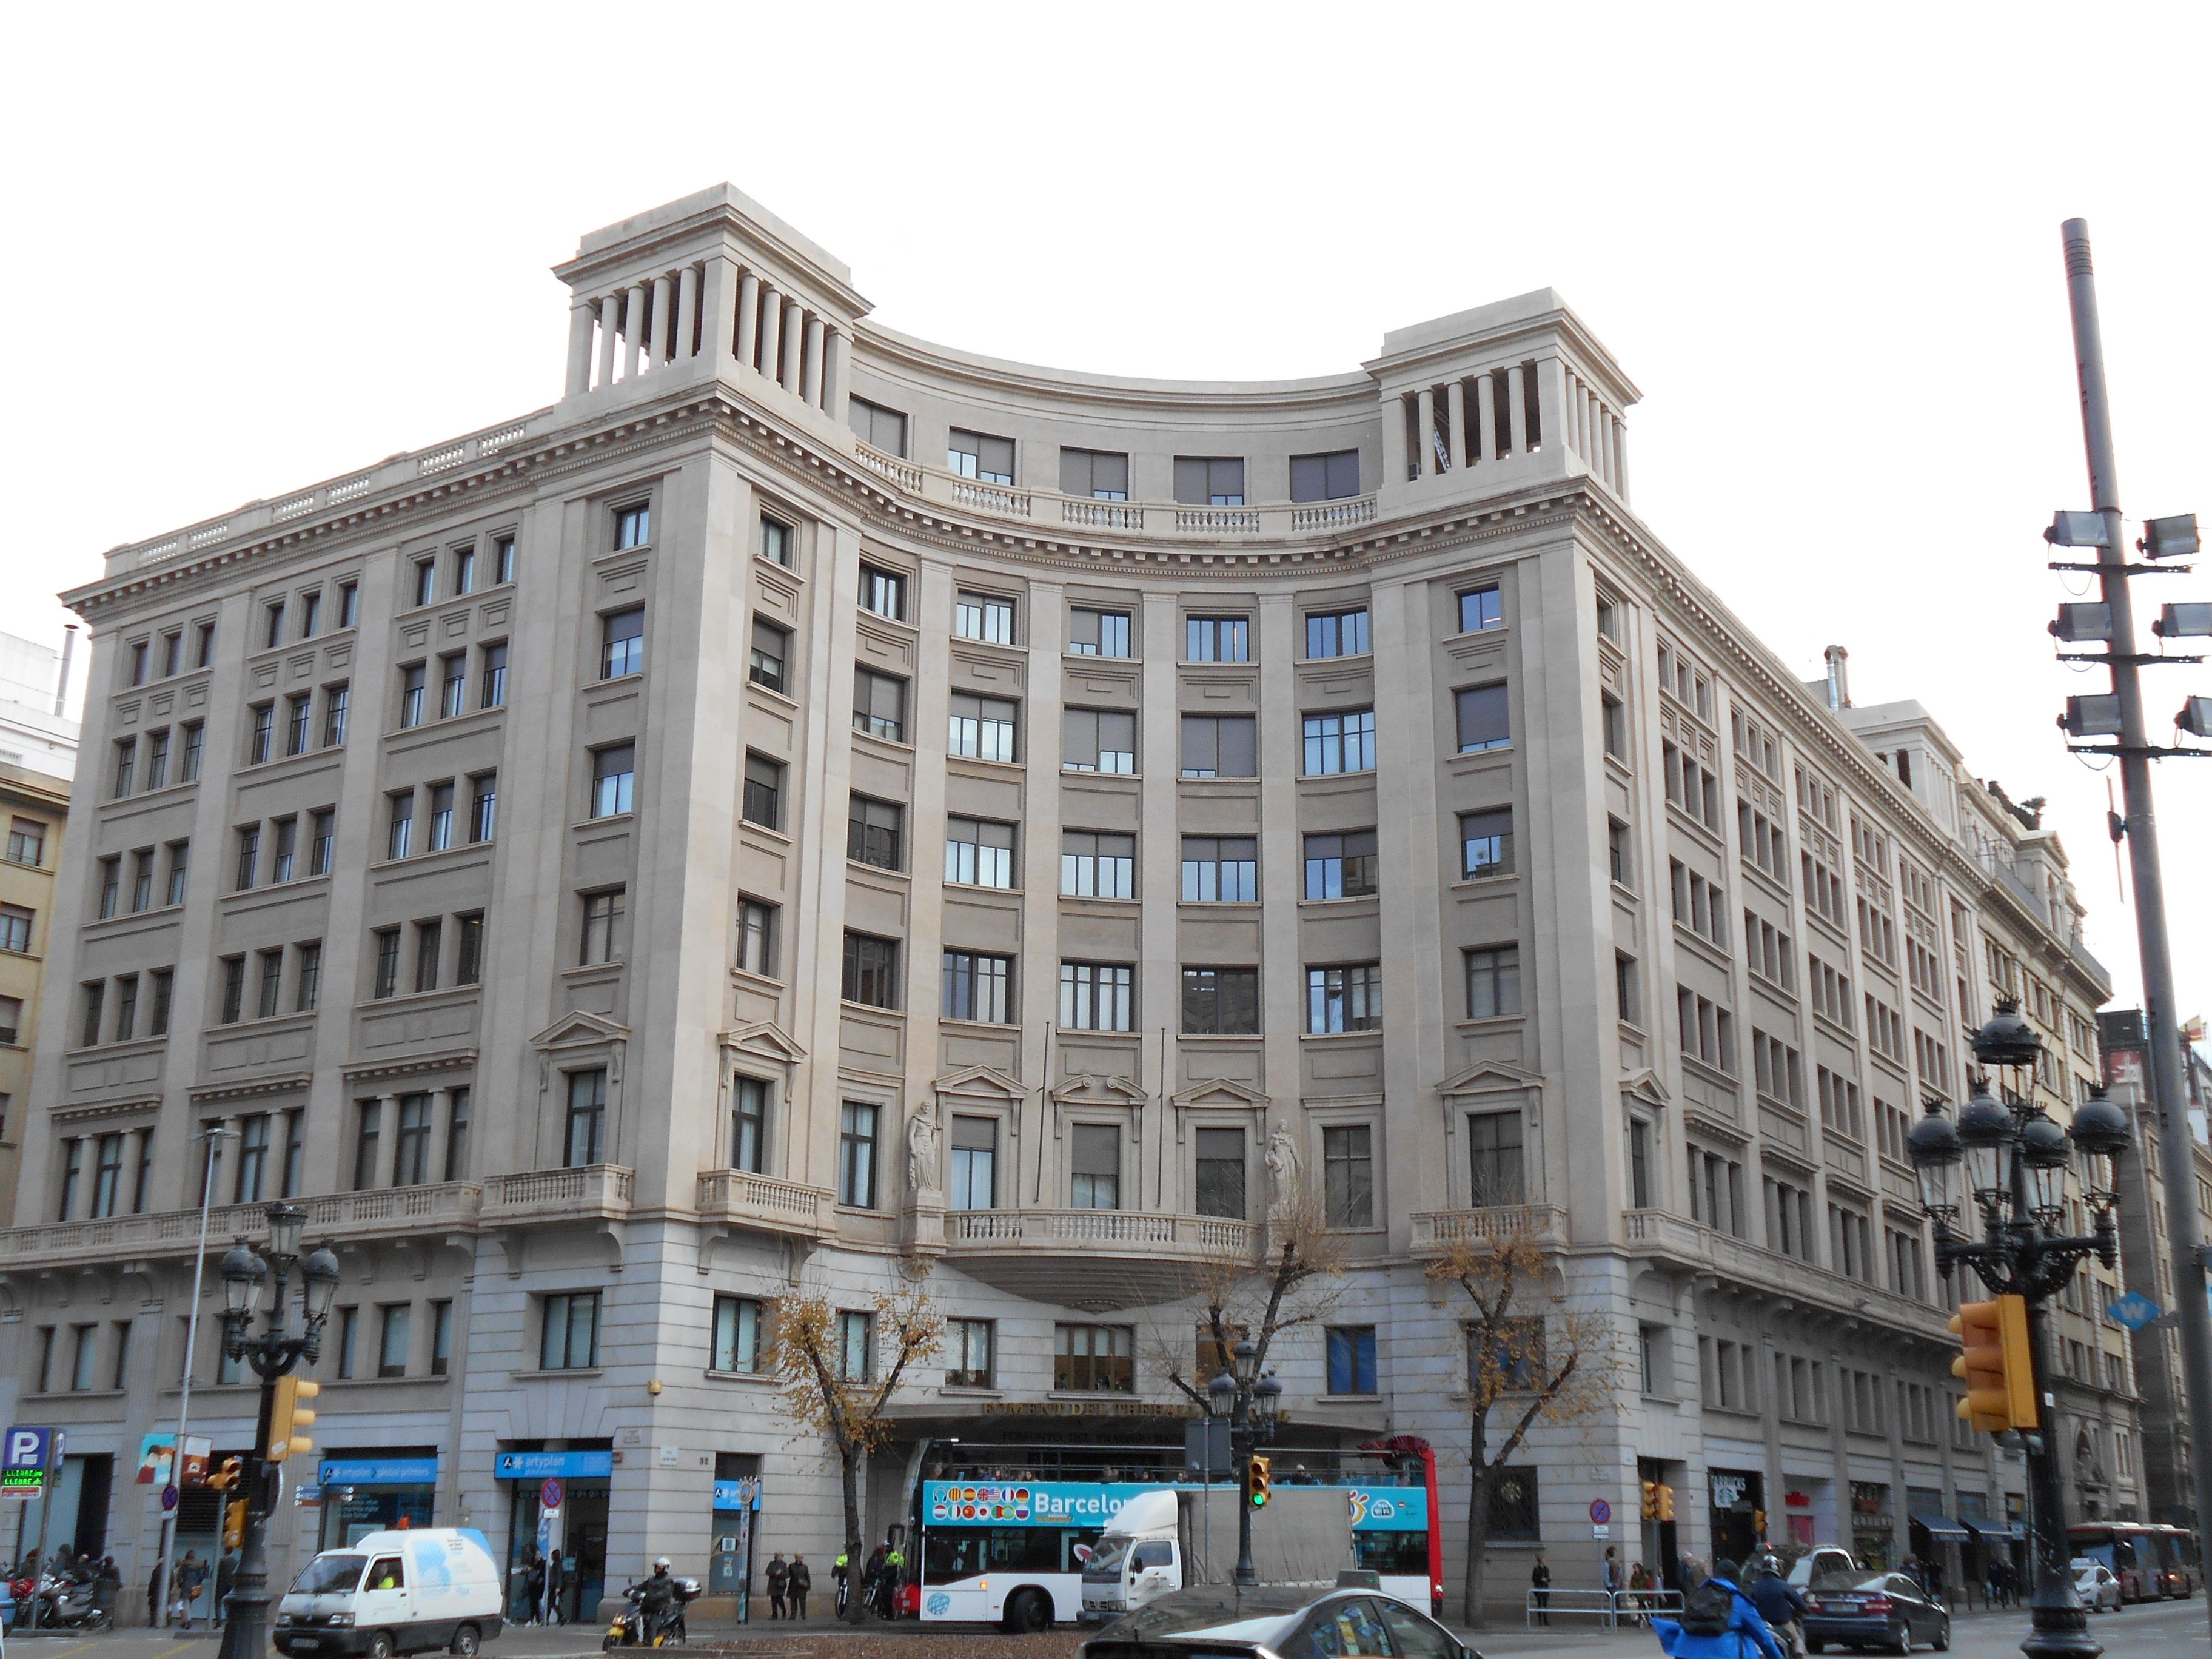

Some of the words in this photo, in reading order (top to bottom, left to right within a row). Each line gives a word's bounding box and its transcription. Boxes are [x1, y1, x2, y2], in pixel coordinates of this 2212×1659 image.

[2119, 1302, 2147, 1320] W
[983, 1403, 1064, 1417] FOMENT
[1071, 1403, 1106, 1417] DEL
[12, 1432, 39, 1464] P
[525, 1456, 565, 1468] artyplan
[1034, 1493, 1128, 1514] Barcelo
